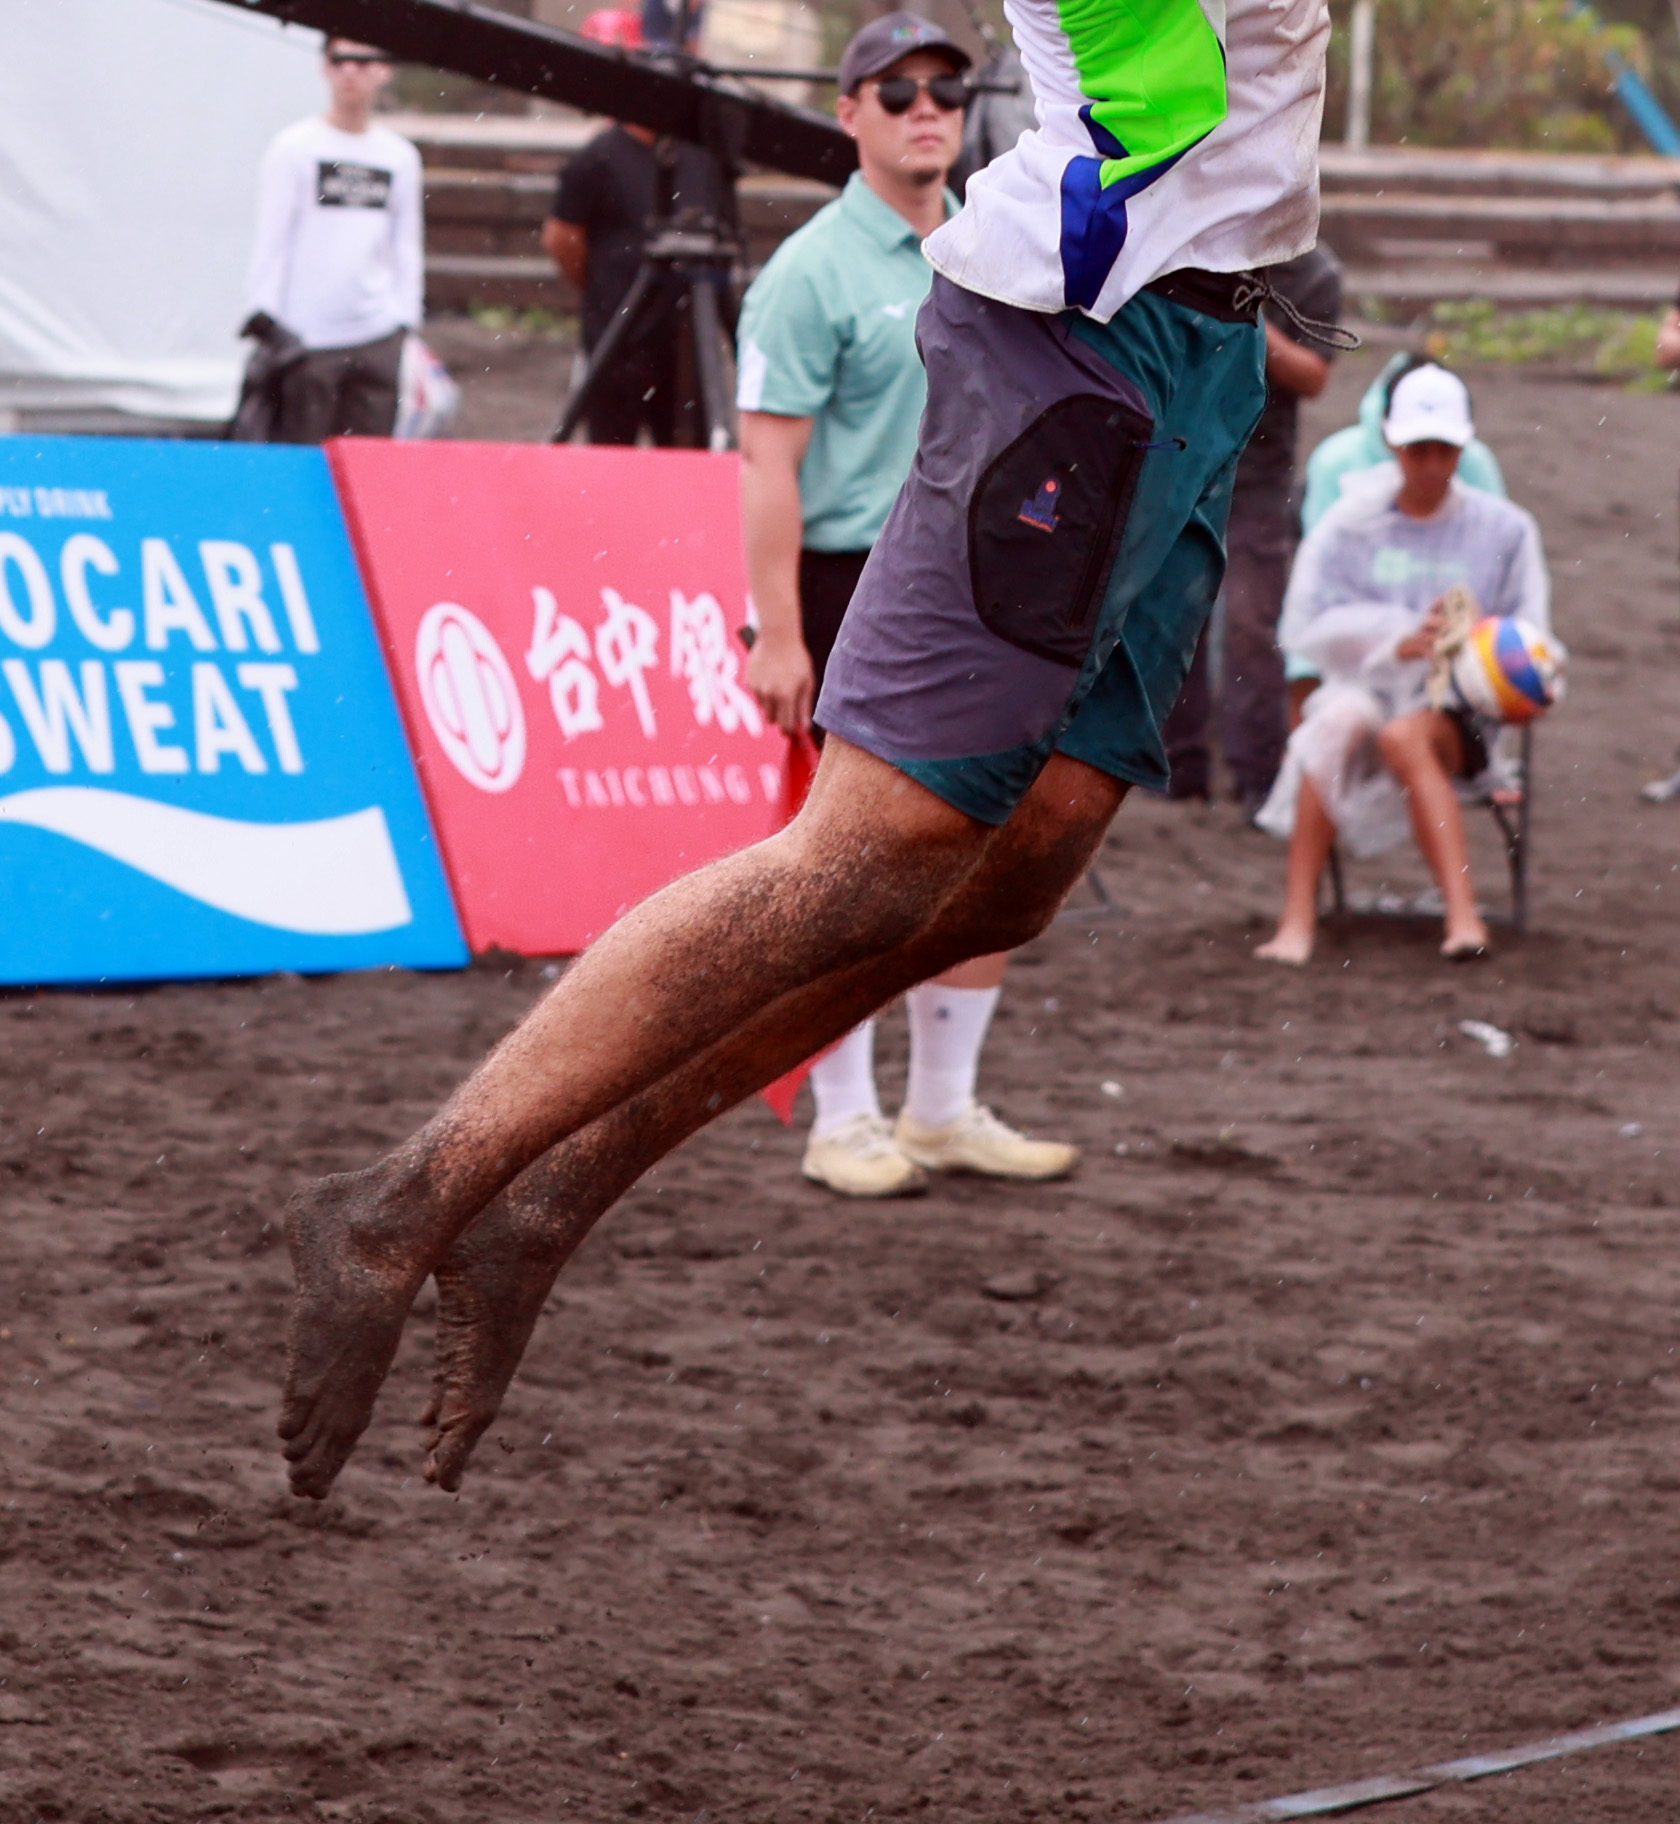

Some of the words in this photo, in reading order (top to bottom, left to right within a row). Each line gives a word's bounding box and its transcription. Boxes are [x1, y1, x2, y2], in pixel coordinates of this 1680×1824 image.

[34, 486, 114, 520] DRINK
[0, 531, 321, 654] OCARI
[0, 658, 305, 775] WEAT
[523, 585, 764, 740] 台中銀
[557, 763, 752, 810] TAICHUNG
